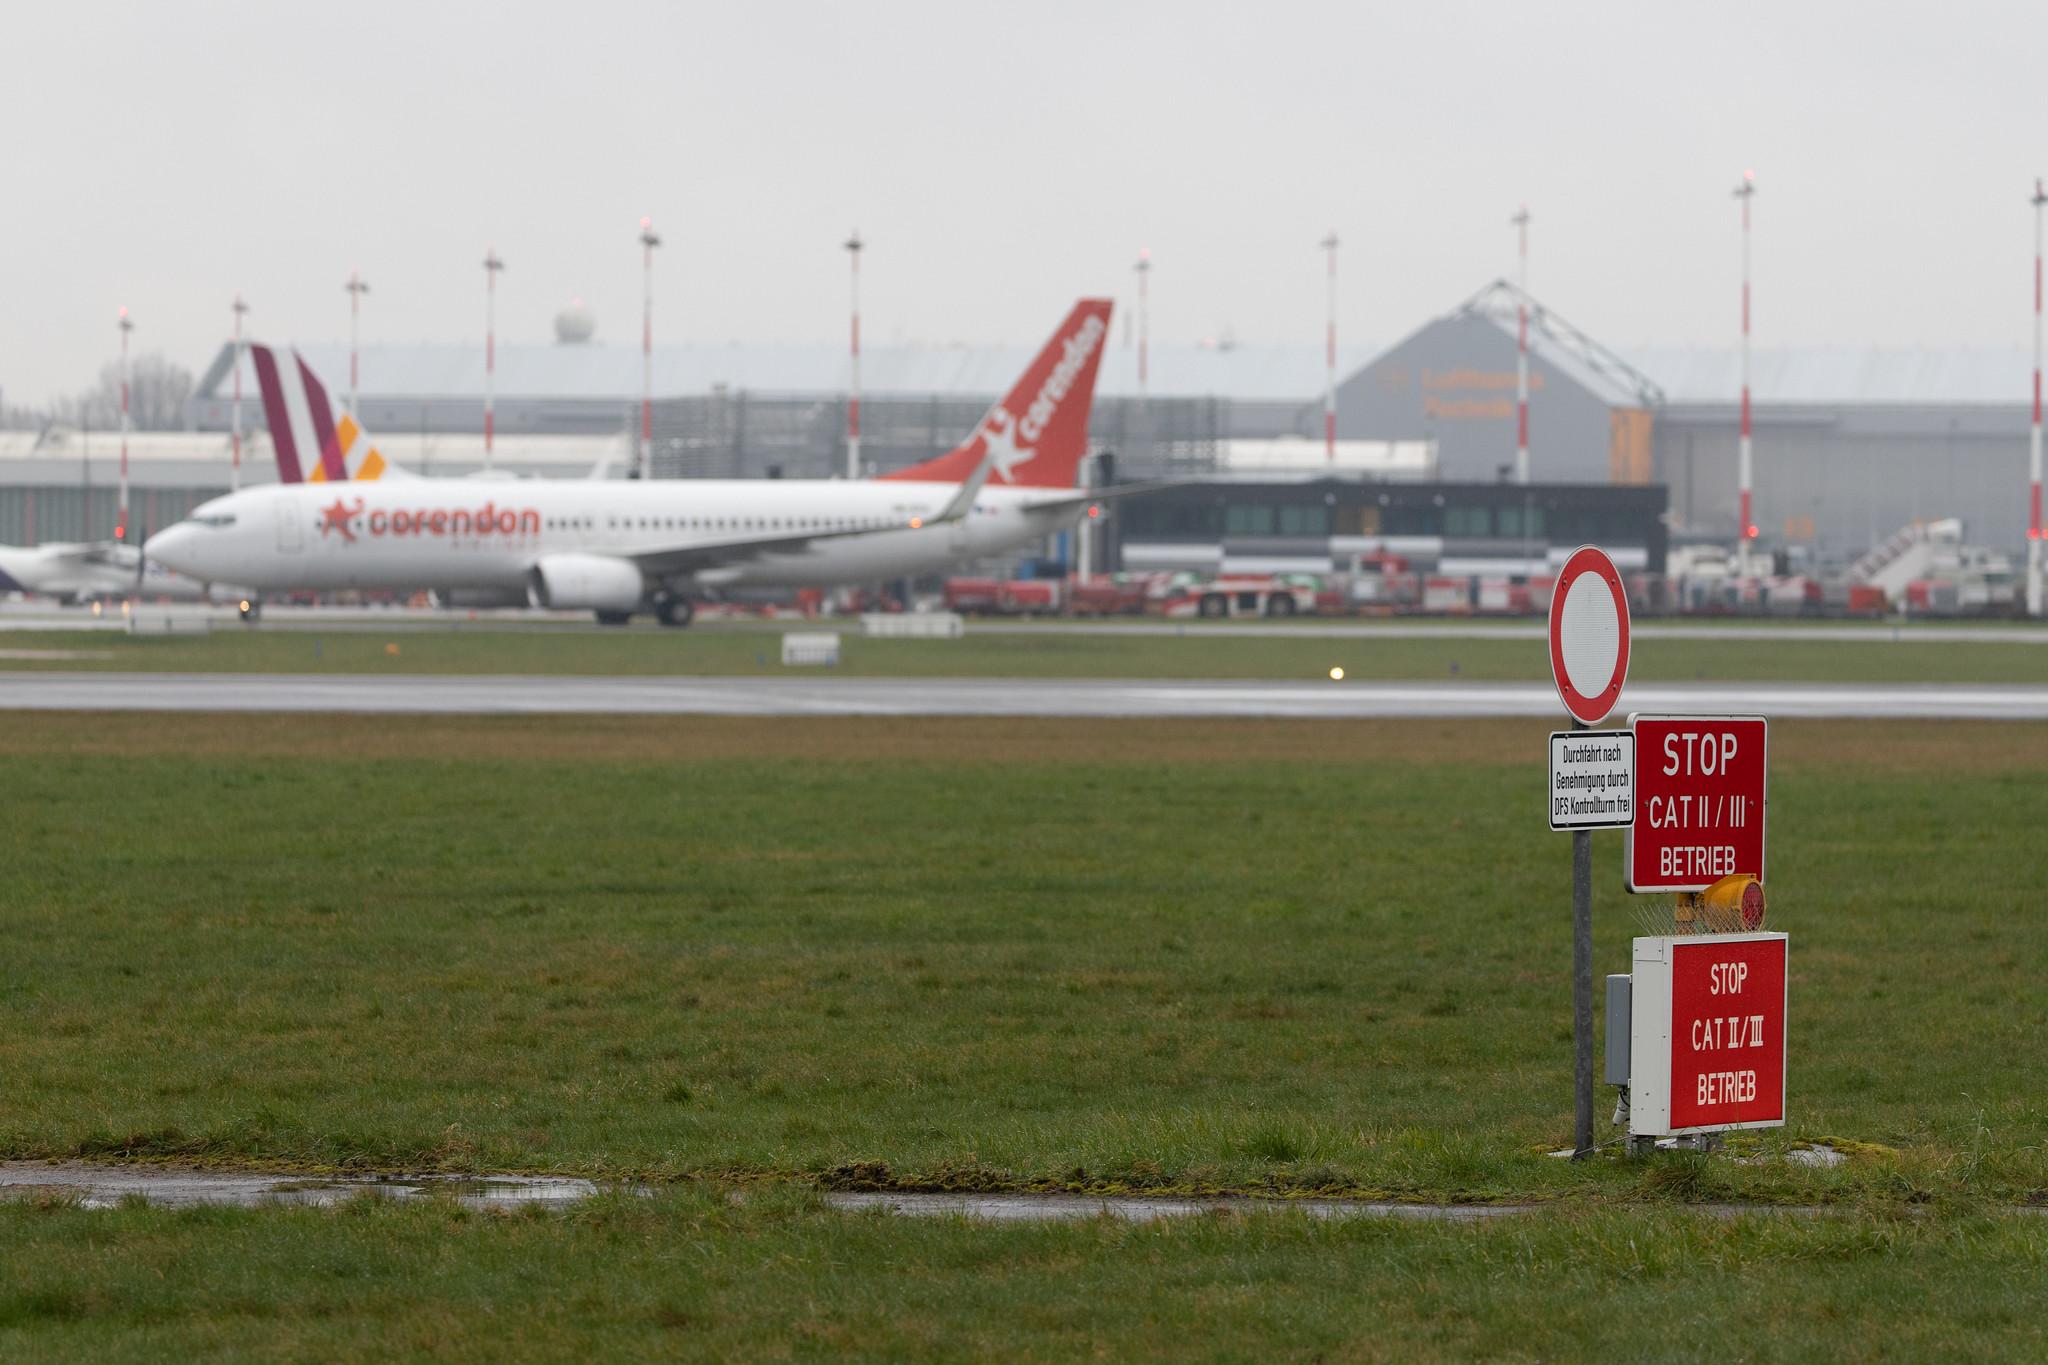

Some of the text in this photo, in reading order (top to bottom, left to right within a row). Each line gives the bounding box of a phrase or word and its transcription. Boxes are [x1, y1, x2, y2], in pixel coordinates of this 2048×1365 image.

[369, 501, 540, 536] corendon
[1563, 744, 1621, 763] Durchfahrt nach
[1662, 732, 1738, 776] STOP
[1556, 768, 1629, 793] Genehmigung durch
[1554, 794, 1630, 816] DFS Kontrollturm frei
[1649, 795, 1693, 829] CAT
[1660, 846, 1736, 876] BETRIEB
[1710, 961, 1748, 996] STOP
[1692, 1017, 1724, 1051] CAT
[1697, 1069, 1757, 1106] BETRIEB
